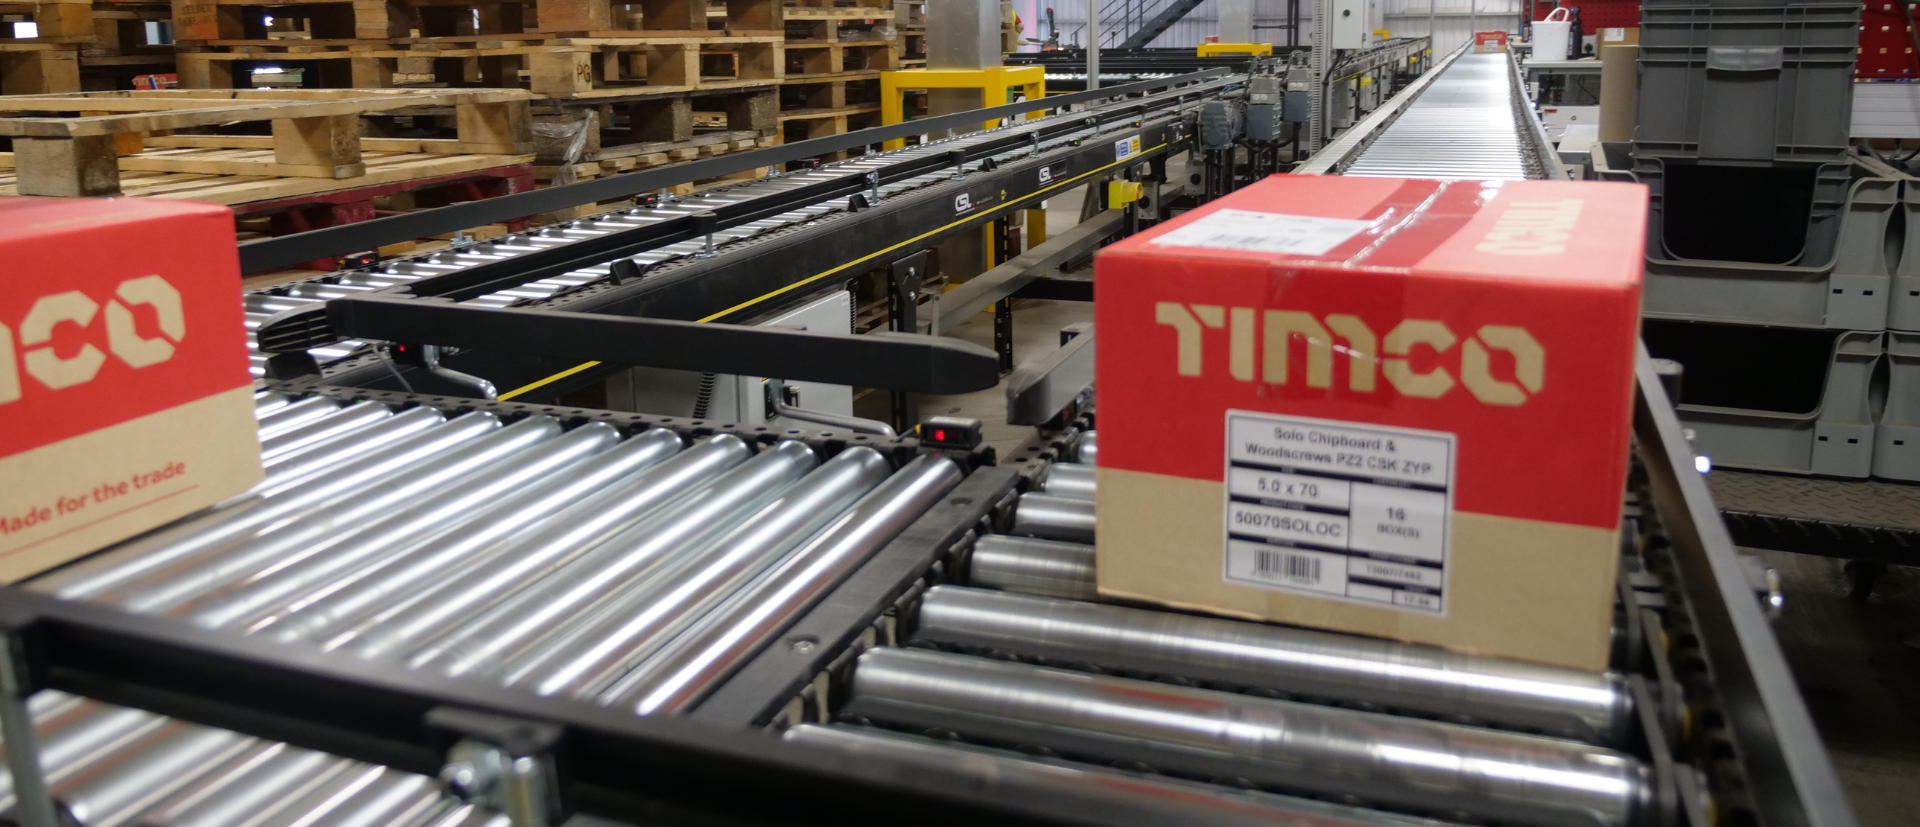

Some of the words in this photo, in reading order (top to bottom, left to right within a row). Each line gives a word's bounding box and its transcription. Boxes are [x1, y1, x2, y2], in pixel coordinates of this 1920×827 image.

[1155, 301, 1547, 408] TIMCO
[1274, 426, 1304, 443] Solo
[1308, 430, 1381, 452] Chipboard
[1385, 440, 1396, 452] &
[1245, 441, 1332, 464] Woodscrews
[1336, 454, 1363, 468] PZ2
[1366, 457, 1398, 472] CSK
[1401, 460, 1432, 475] ZYP
[0, 505, 52, 538] Made
[56, 490, 90, 517] for
[93, 476, 129, 504] the
[132, 460, 187, 490] trade
[1257, 477, 1281, 493] 5.0
[1285, 484, 1293, 495] x
[1299, 482, 1318, 498] 70
[1235, 510, 1343, 538] 50070SOLOC
[1377, 523, 1421, 540] BOX(S)
